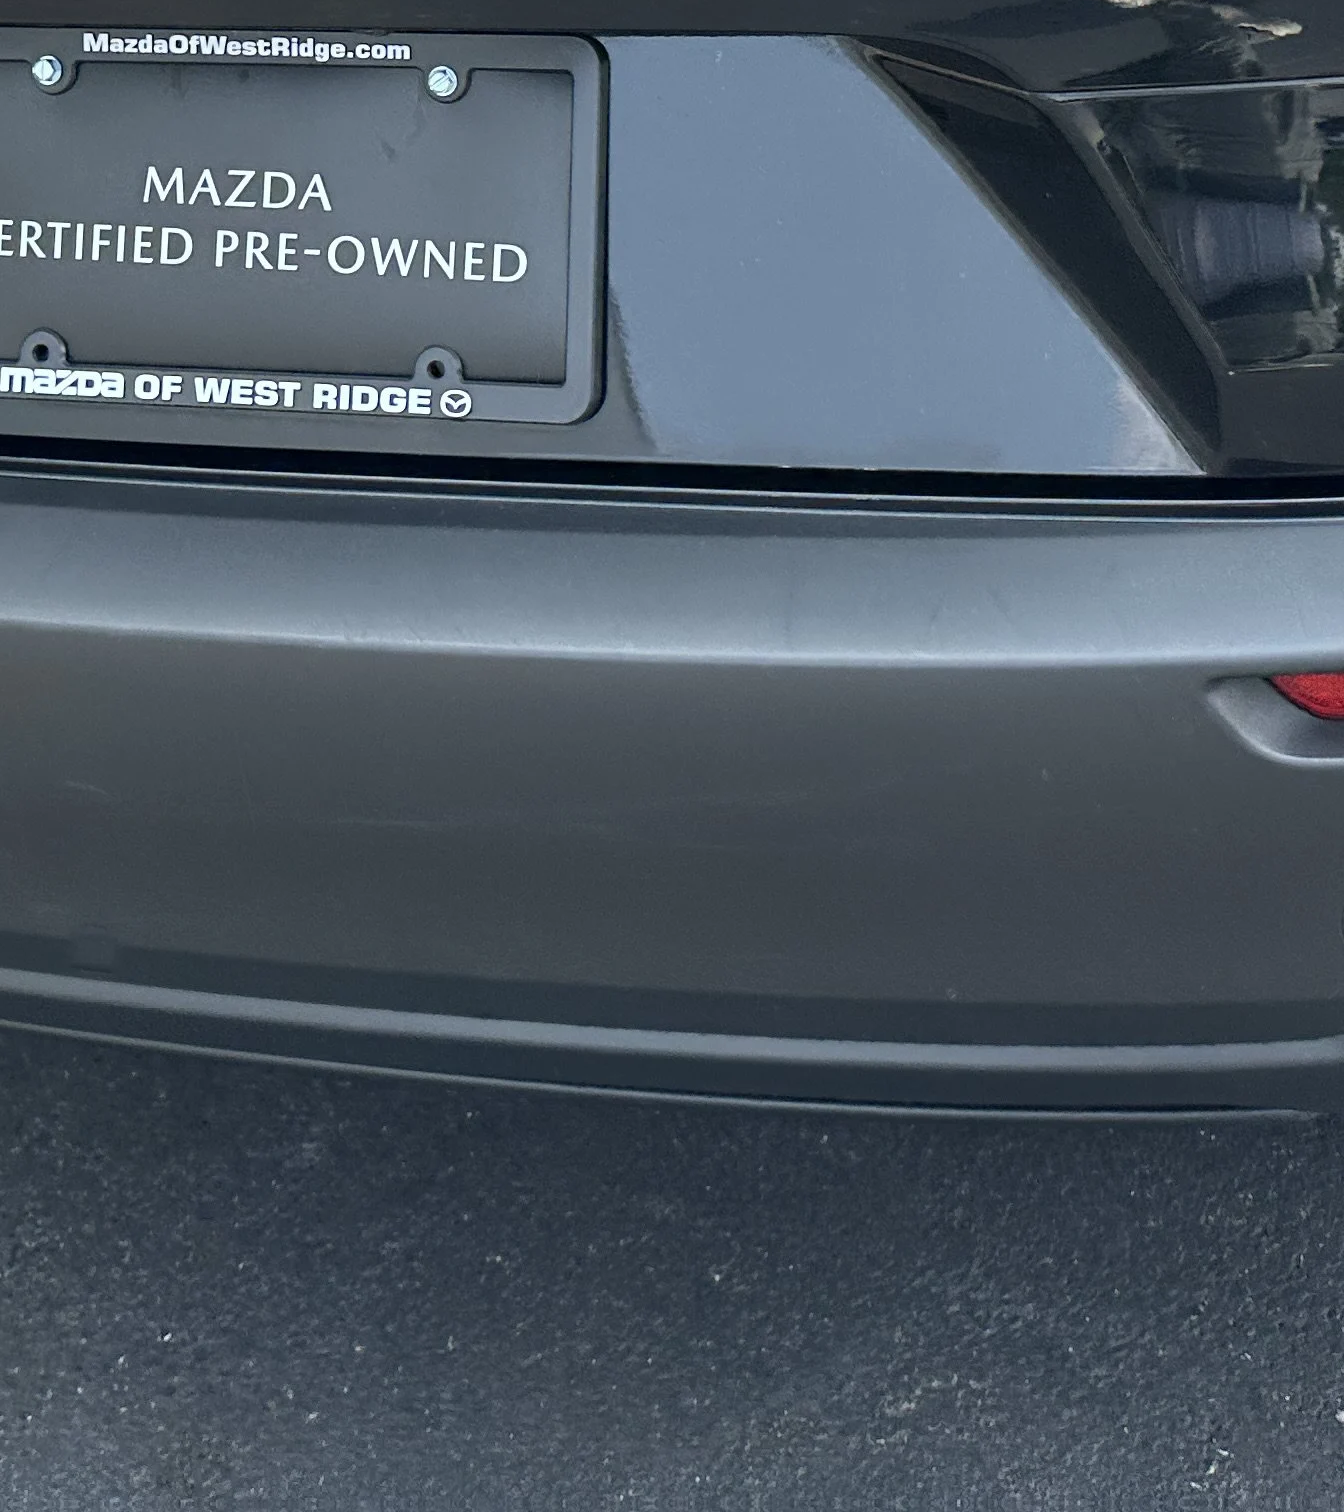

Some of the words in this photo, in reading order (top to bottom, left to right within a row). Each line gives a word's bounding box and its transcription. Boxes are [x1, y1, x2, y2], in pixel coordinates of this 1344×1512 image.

[82, 32, 412, 63] MazdaOfWestRidge.com
[142, 165, 332, 212] MAZDA
[214, 229, 528, 283] PRE-OWNED
[134, 373, 183, 401] OF
[193, 376, 302, 408] WEST
[312, 383, 432, 415] RIDGE
